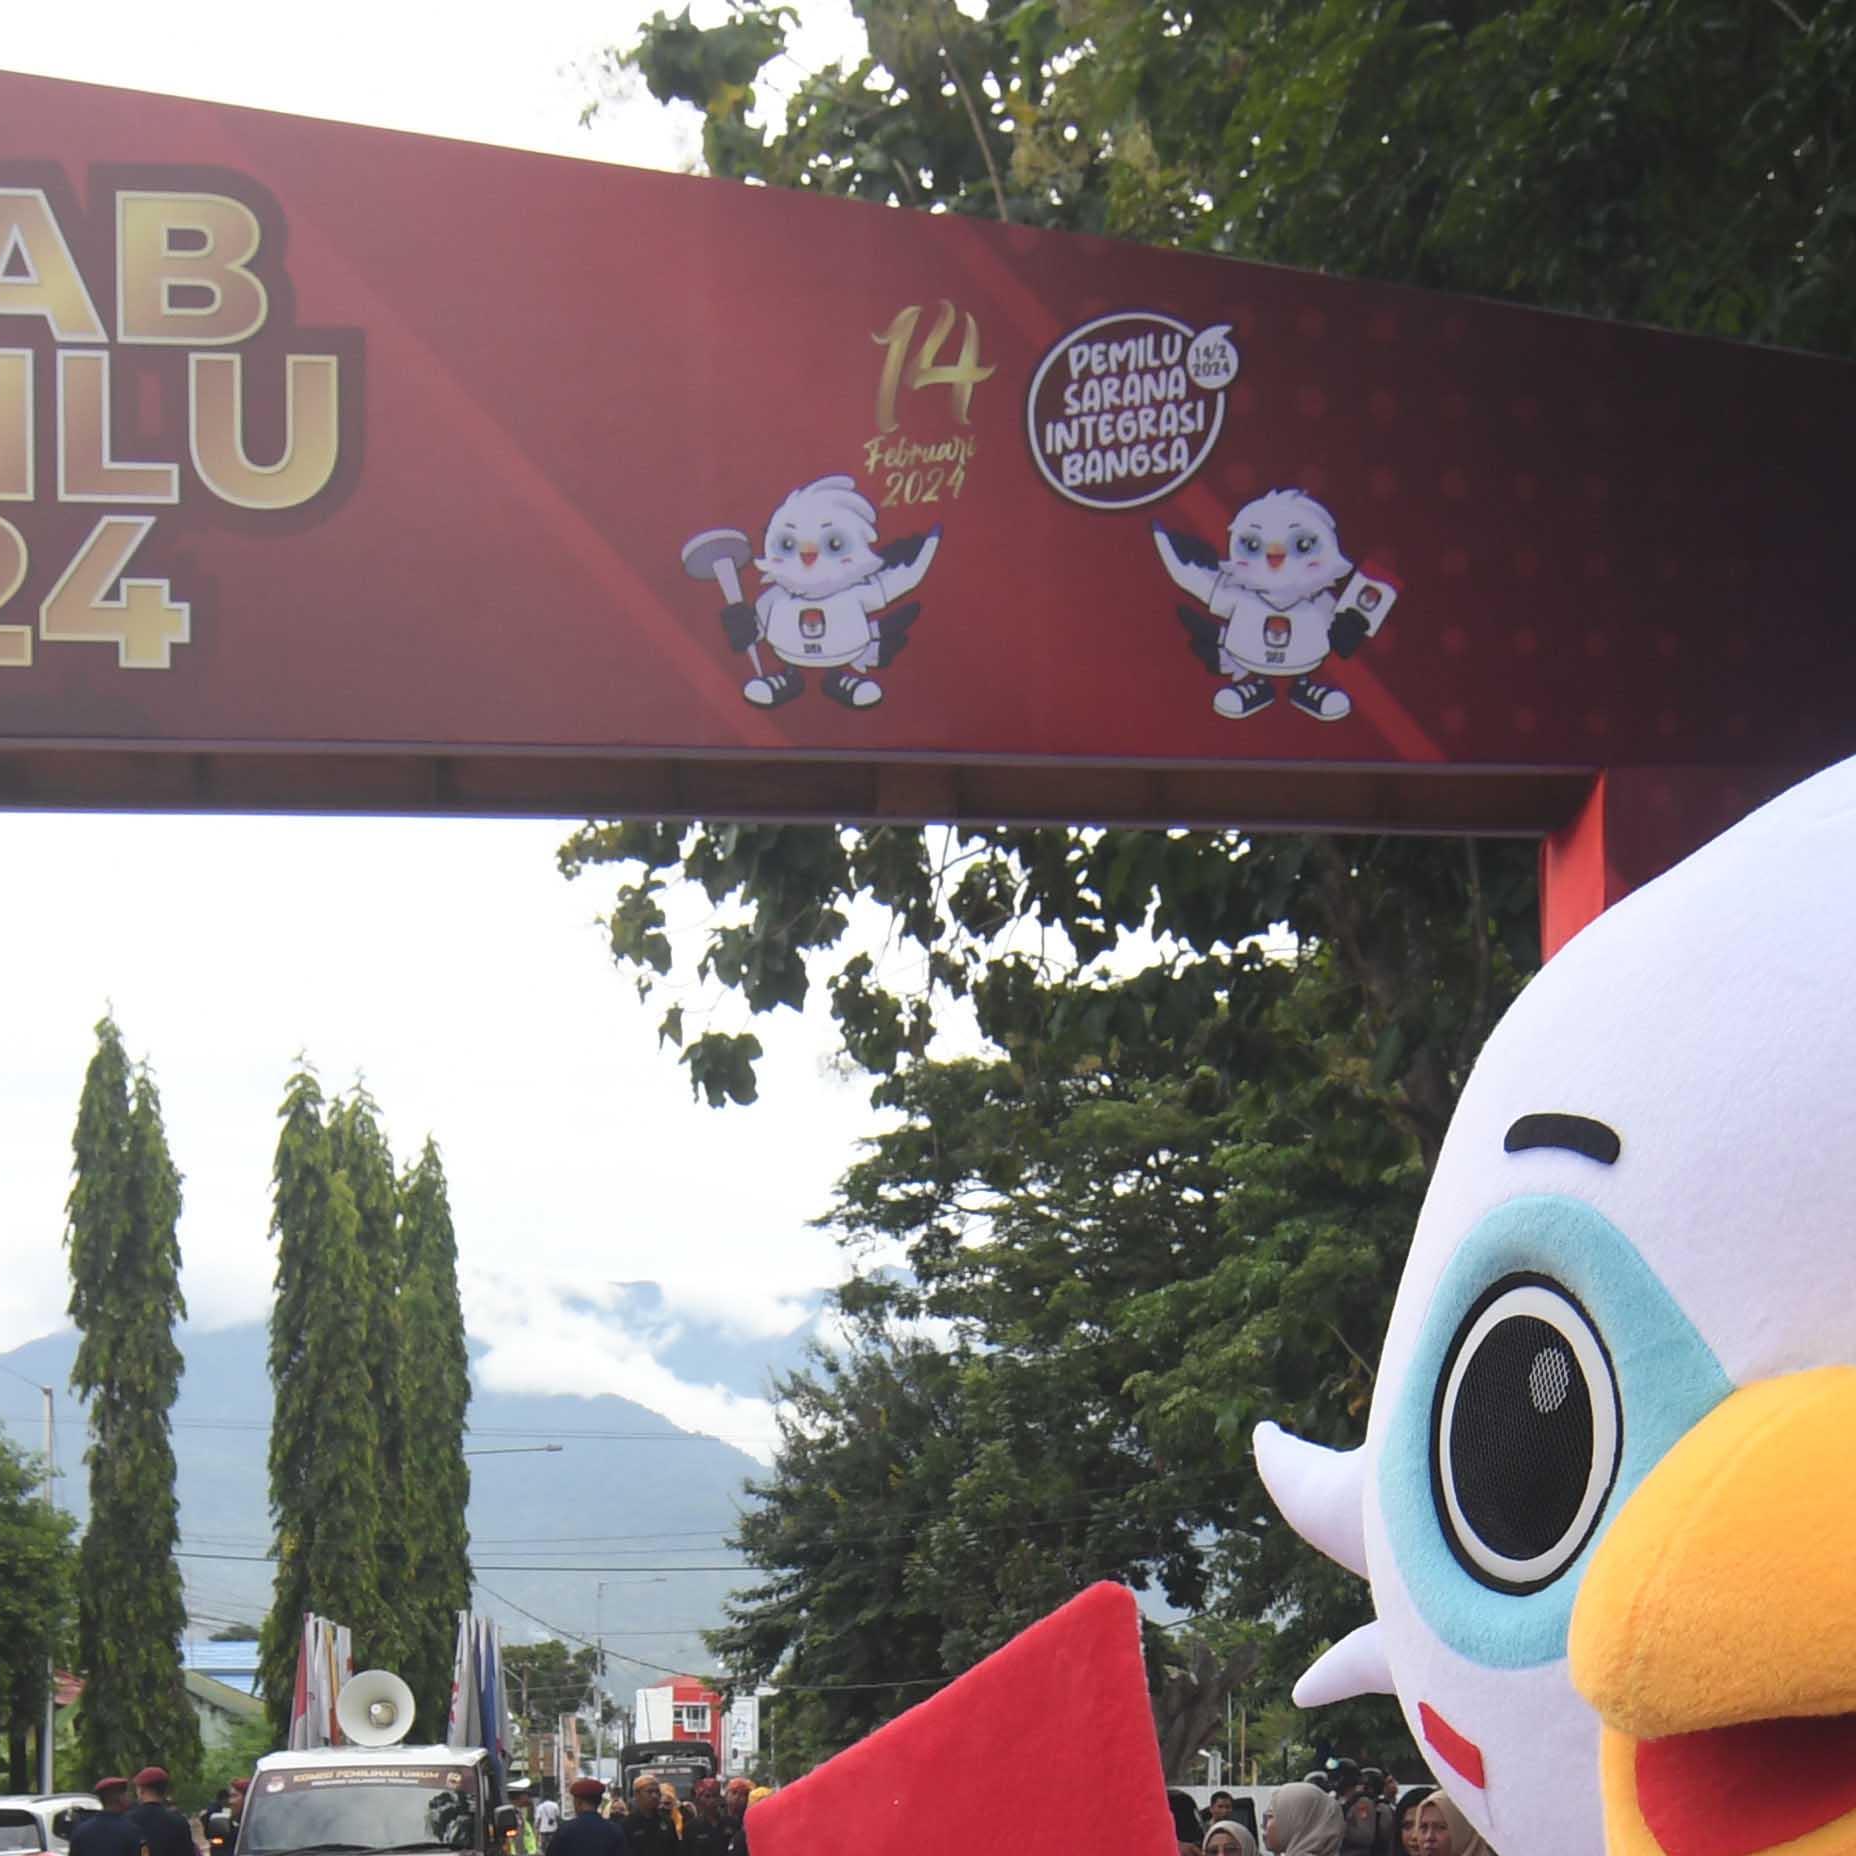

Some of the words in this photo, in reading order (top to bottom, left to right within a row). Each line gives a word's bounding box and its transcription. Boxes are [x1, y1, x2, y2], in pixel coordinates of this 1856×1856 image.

[871, 299, 996, 432] 14
[1068, 332, 1183, 380] PEMILU
[1193, 361, 1231, 377] 2024
[1194, 342, 1228, 360] 14/2
[1063, 365, 1187, 416] SARANA
[1045, 399, 1205, 455] INTEGRASI
[863, 433, 976, 475] Februari
[1061, 437, 1189, 487] BANGSA
[881, 464, 966, 508] 2024
